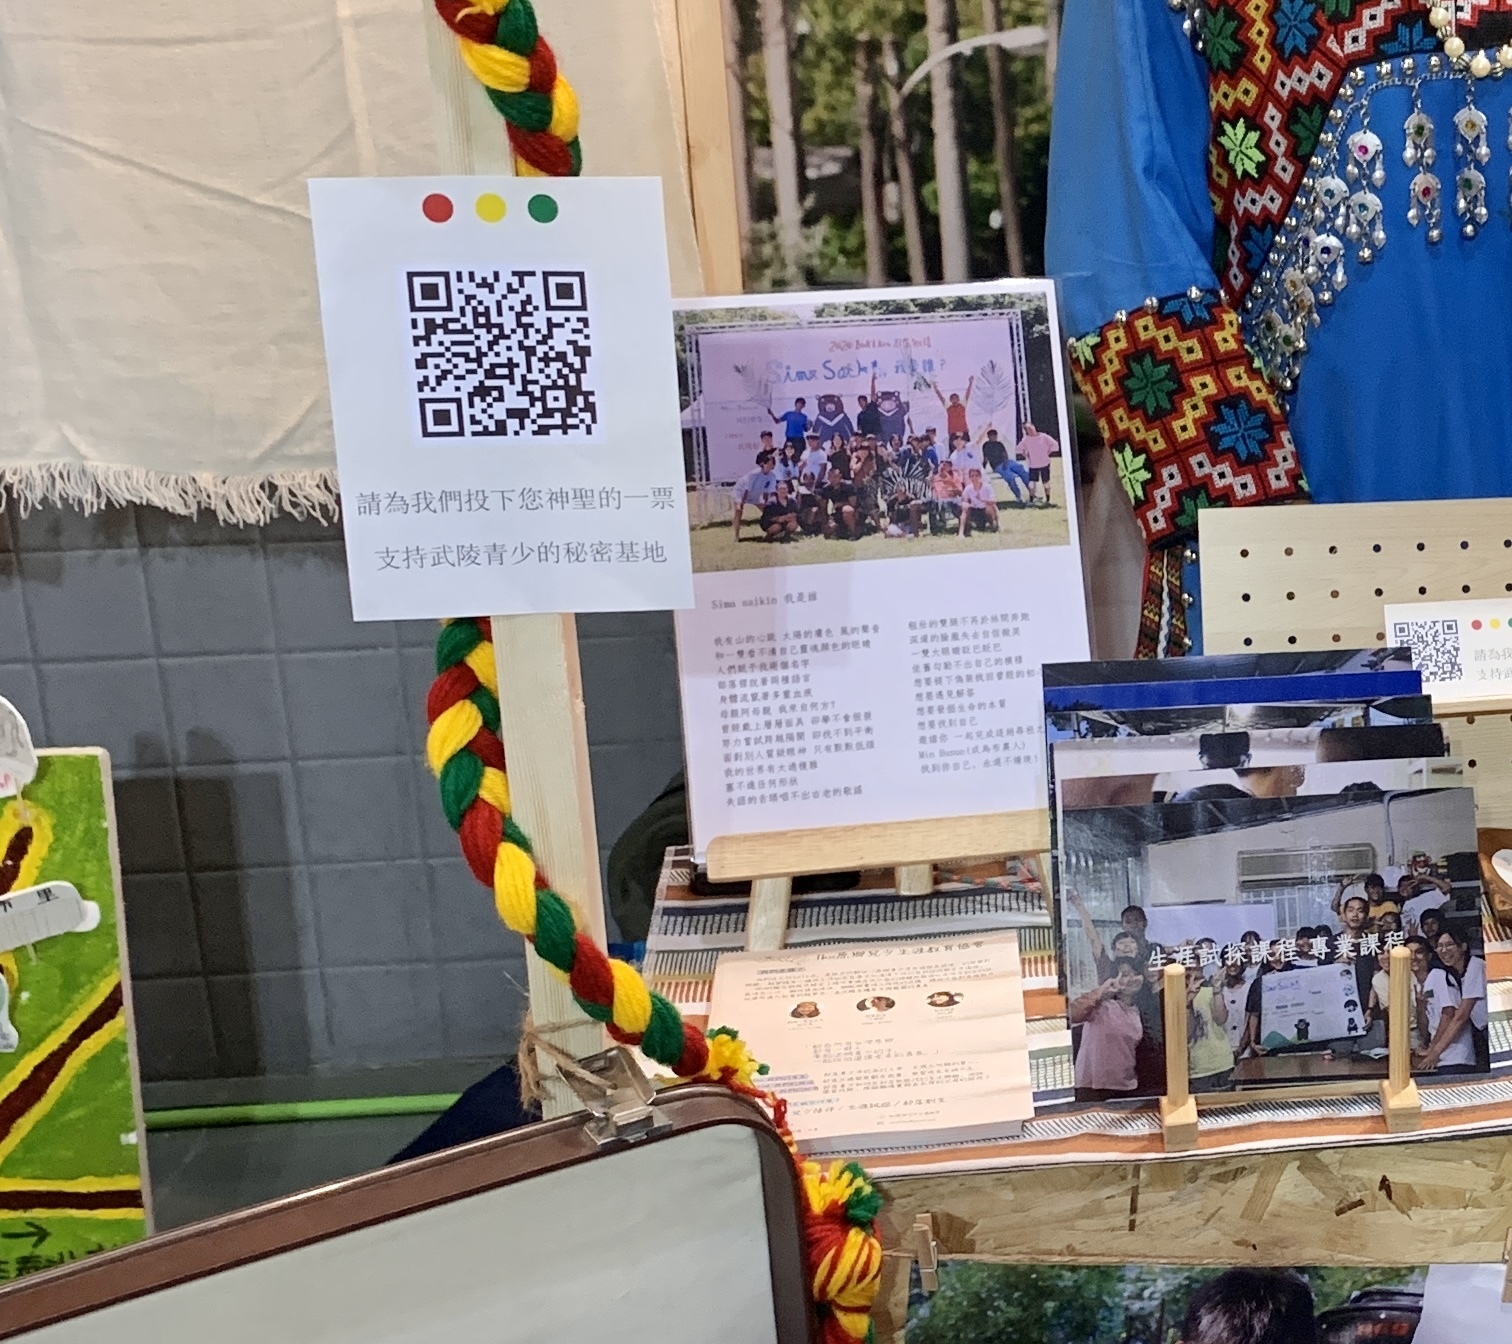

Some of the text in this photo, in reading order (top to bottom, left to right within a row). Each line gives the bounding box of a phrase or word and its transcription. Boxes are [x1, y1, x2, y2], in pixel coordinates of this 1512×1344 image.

[355, 486, 675, 517] 請為我們投下您神聖的一票
[374, 540, 668, 571] 支持武陵青少的秘密基地
[1148, 930, 1405, 972] 生涯試探課程 專業課程
